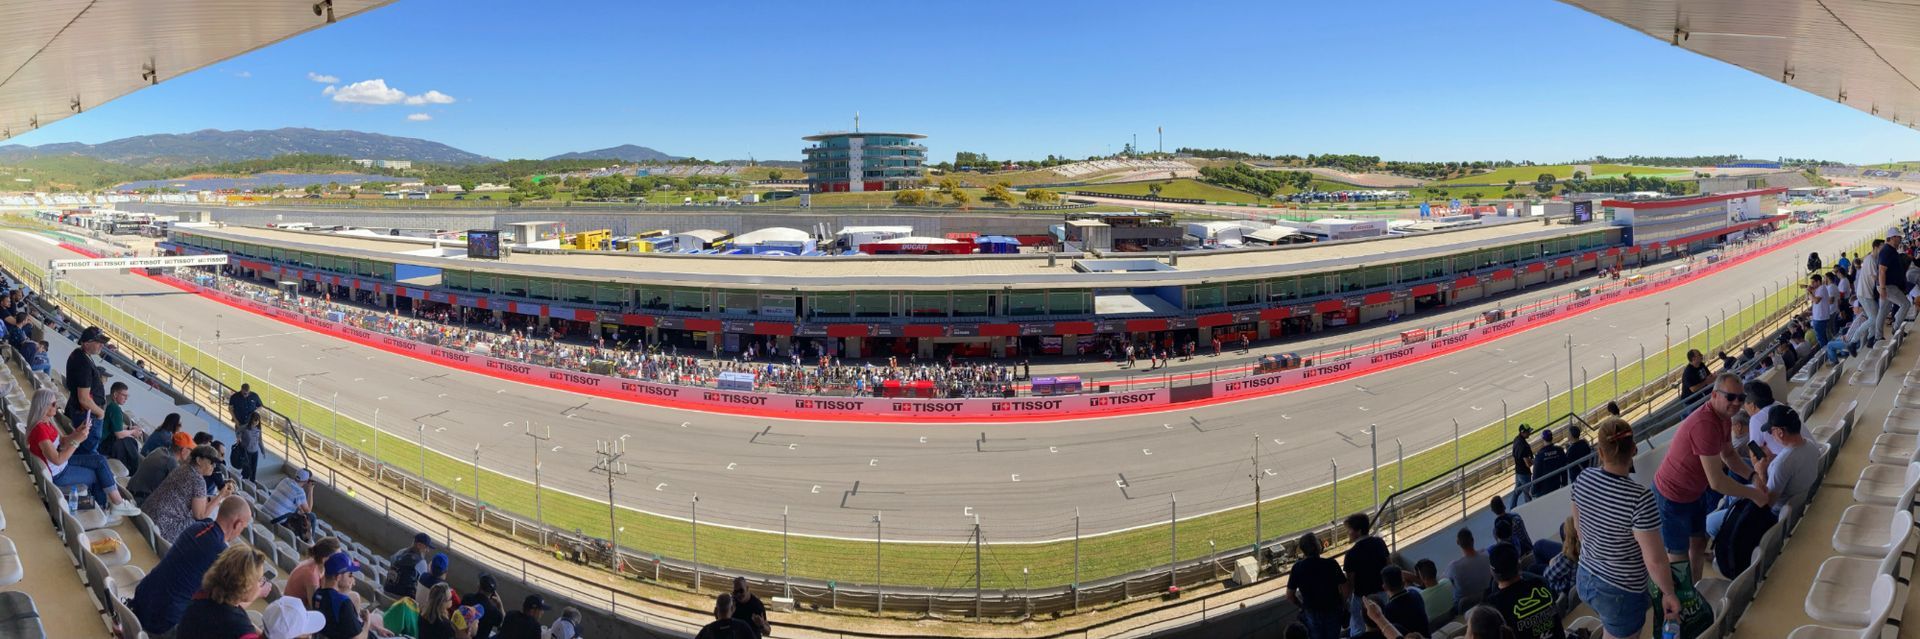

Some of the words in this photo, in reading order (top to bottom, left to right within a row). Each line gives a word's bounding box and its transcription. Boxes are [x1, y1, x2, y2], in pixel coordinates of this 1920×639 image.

[1491, 319, 1516, 332] TISSOT
[391, 338, 417, 350] TISSOT
[1442, 333, 1469, 347] TISSOT
[440, 349, 470, 362] TISSOT
[1383, 347, 1415, 361] TISSOT
[498, 362, 531, 375] TISSOT
[1316, 361, 1352, 375] TISSOT
[563, 373, 600, 386] TISSOT
[1241, 375, 1282, 389] TISSOT
[636, 383, 679, 398] TISSOT
[720, 393, 768, 406] TISSOT
[814, 399, 864, 411] TISSOT
[1108, 392, 1156, 405] TISSOT
[912, 402, 964, 412] TISSOT
[1011, 400, 1062, 411] TISSOT
